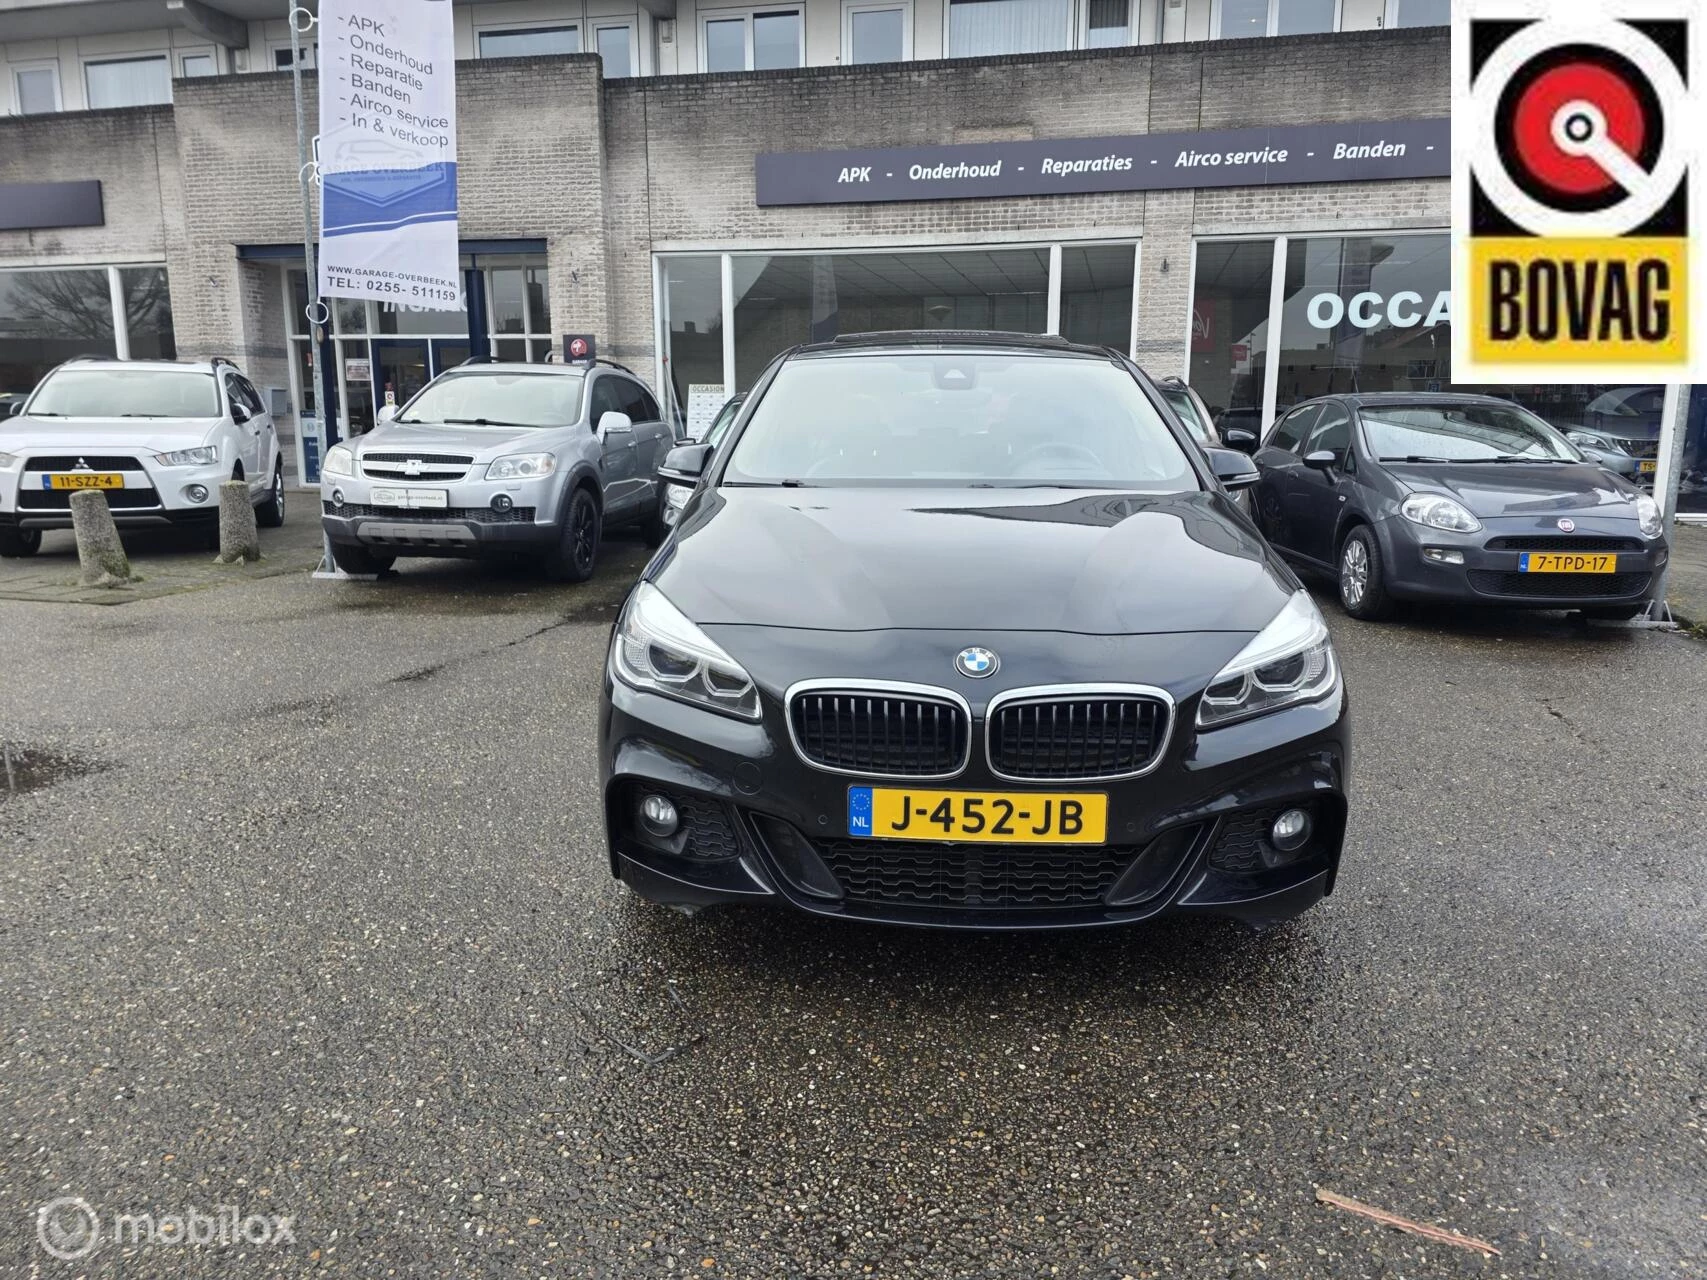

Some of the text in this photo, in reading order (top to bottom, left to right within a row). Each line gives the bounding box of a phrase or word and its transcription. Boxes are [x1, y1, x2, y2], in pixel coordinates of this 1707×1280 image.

[348, 15, 385, 37] APK
[350, 34, 433, 75] Onderhoud
[351, 54, 423, 90] Reparatie
[352, 74, 411, 104] Banden
[350, 93, 392, 115] Airco
[397, 108, 449, 128] service
[352, 113, 367, 128] In
[373, 118, 384, 133] &
[390, 126, 449, 148] verkoop
[838, 166, 872, 183] APK
[909, 160, 1002, 180] Onderhoud
[1041, 154, 1133, 176] Reparaties
[1175, 151, 1222, 168] Airco
[1225, 147, 1288, 165] service
[1333, 140, 1406, 159] Banden
[327, 265, 457, 288] WWW.GARAGE-OVERBEEK.NL
[327, 276, 456, 300] TEL: 0255- 511159
[1307, 291, 1451, 329] OCCA
[60, 476, 112, 487] 11-SZZ-4
[1538, 556, 1608, 570] 7-TPD-17
[853, 796, 1084, 835] NL J-452-JB
